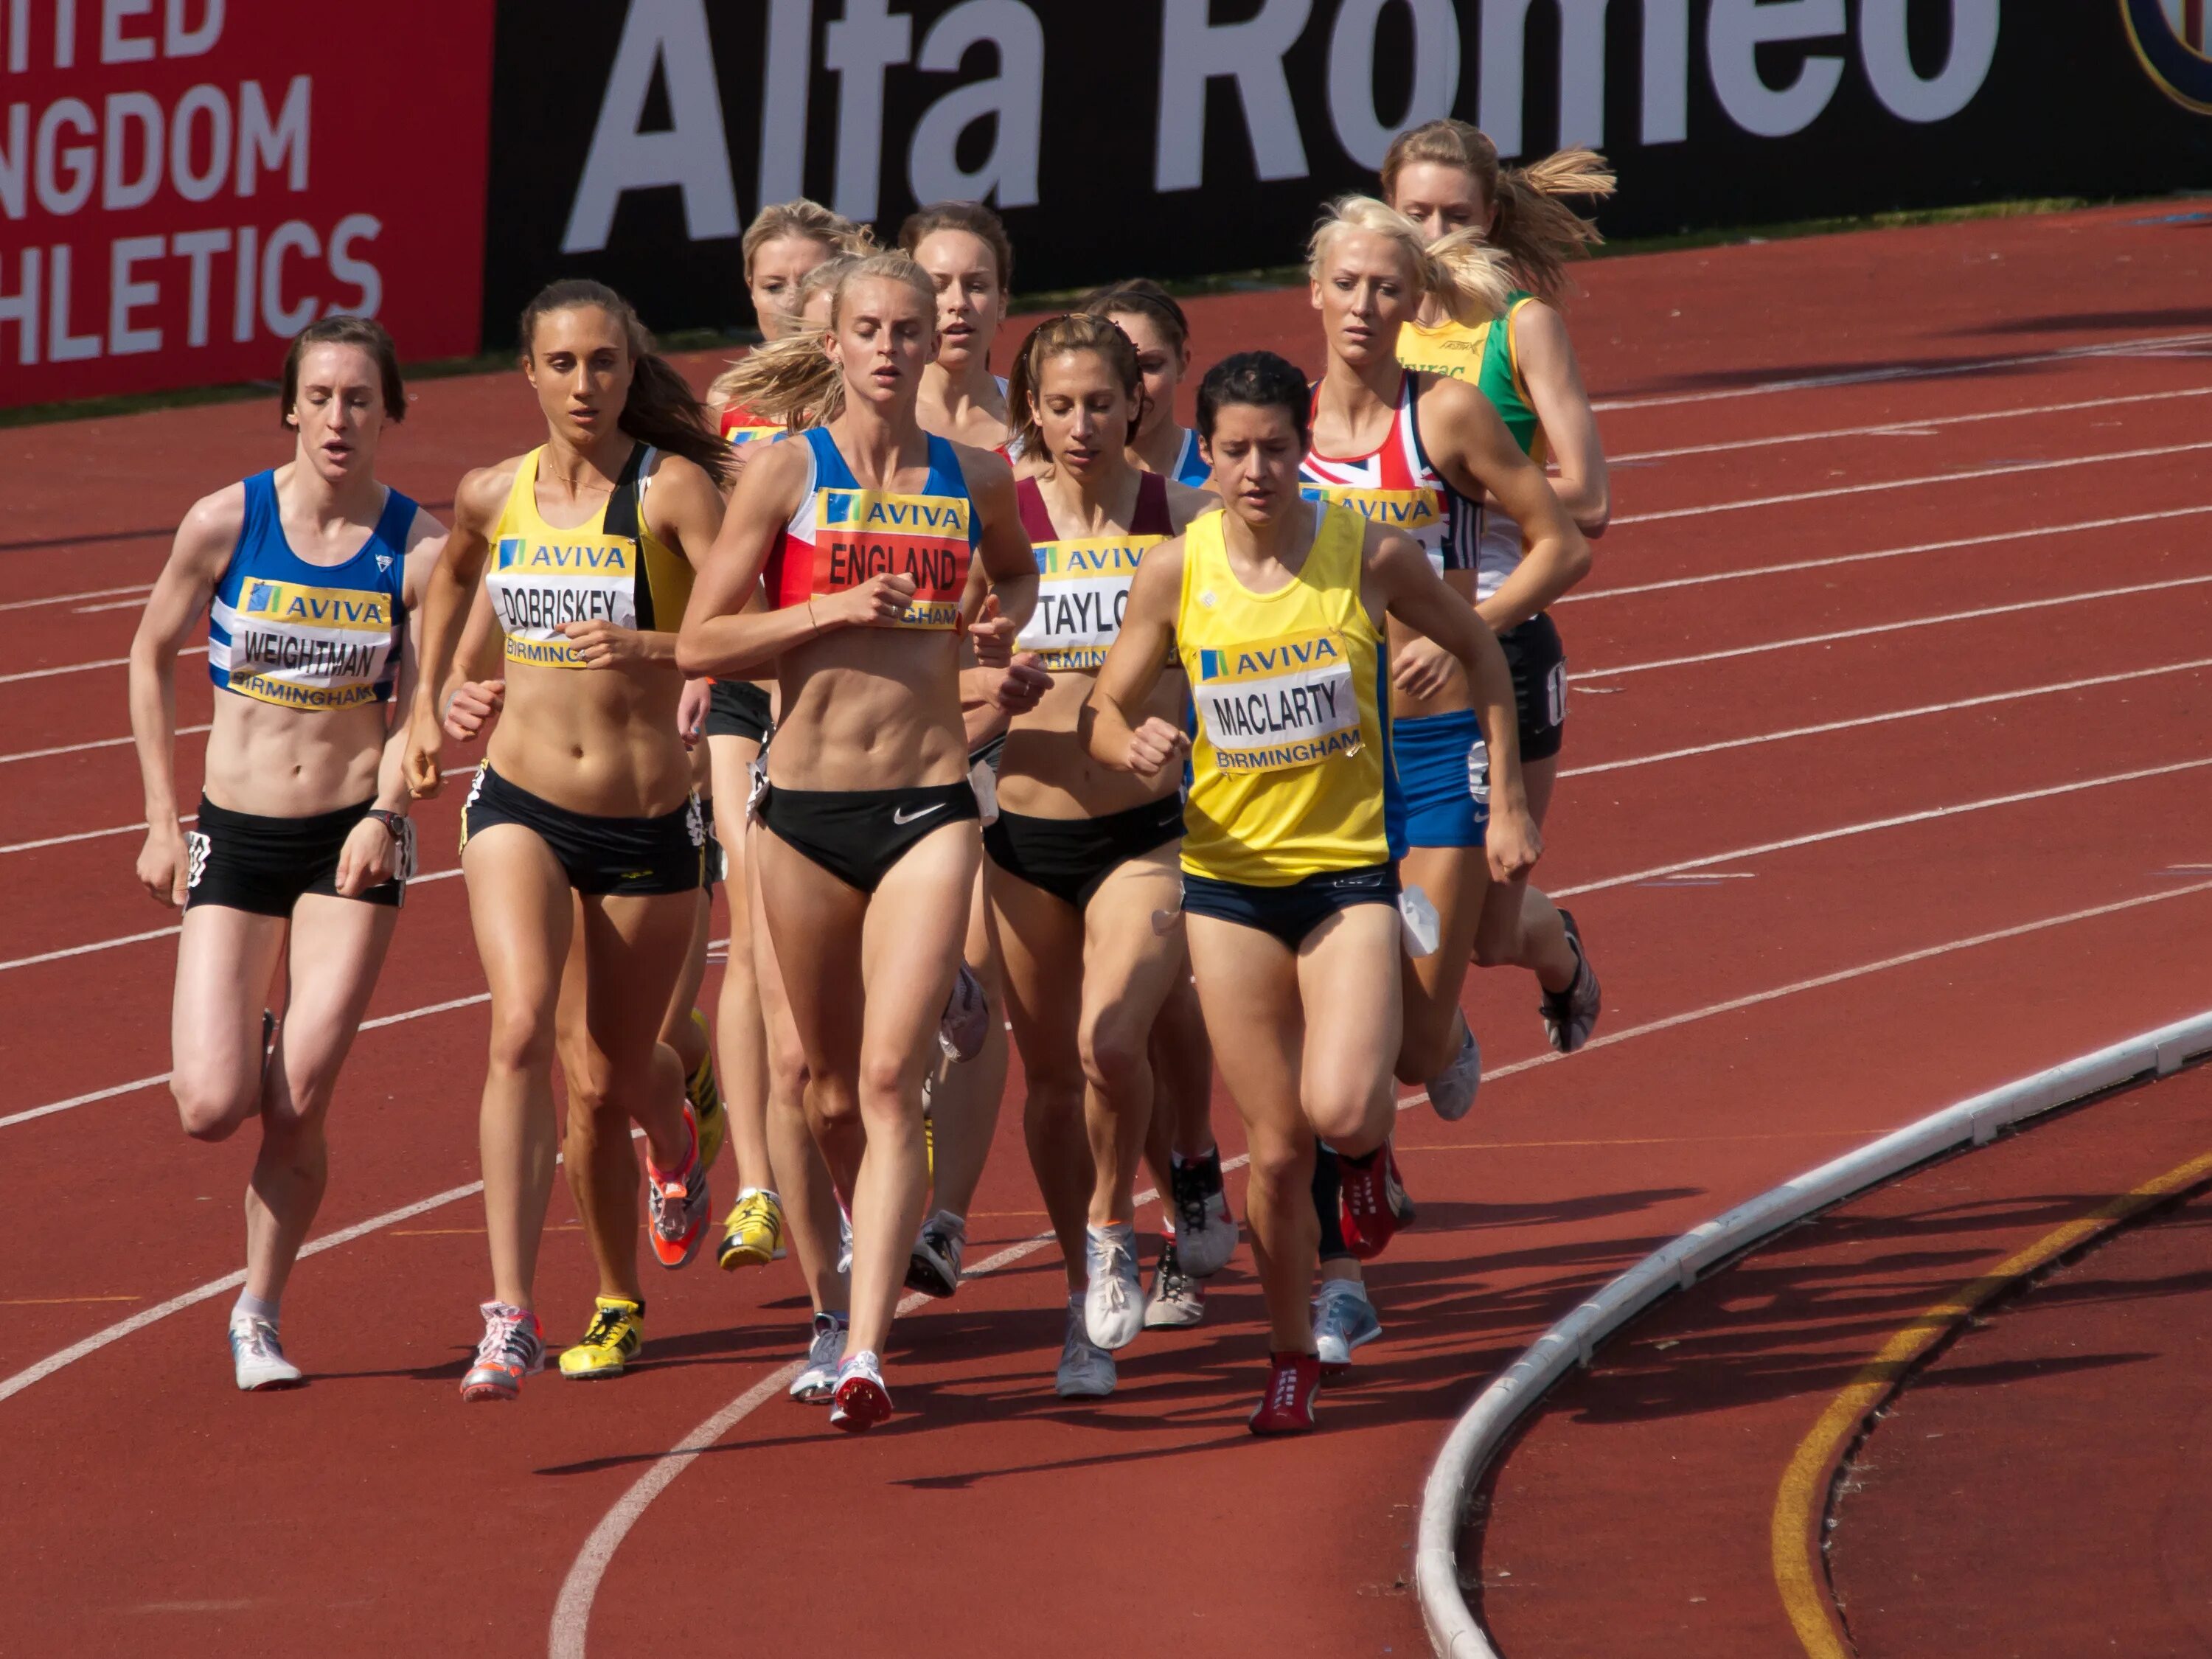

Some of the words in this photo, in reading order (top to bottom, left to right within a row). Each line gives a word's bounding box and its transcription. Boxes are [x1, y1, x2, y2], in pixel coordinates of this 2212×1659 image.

[560, 0, 1045, 254] Alfa
[1155, 0, 2000, 192] Romeo
[866, 501, 961, 530] AVIVA
[1342, 498, 1432, 522] AVIVA
[531, 546, 625, 568] AVIVA
[286, 596, 383, 624] AVIVA
[245, 630, 376, 678] WEIGHTMAN
[1237, 637, 1338, 675] AVIVA
[231, 670, 373, 706] BIRMINGHAM
[1213, 680, 1336, 736] MACLARTY
[1217, 728, 1361, 768] BIRMINGHAM
